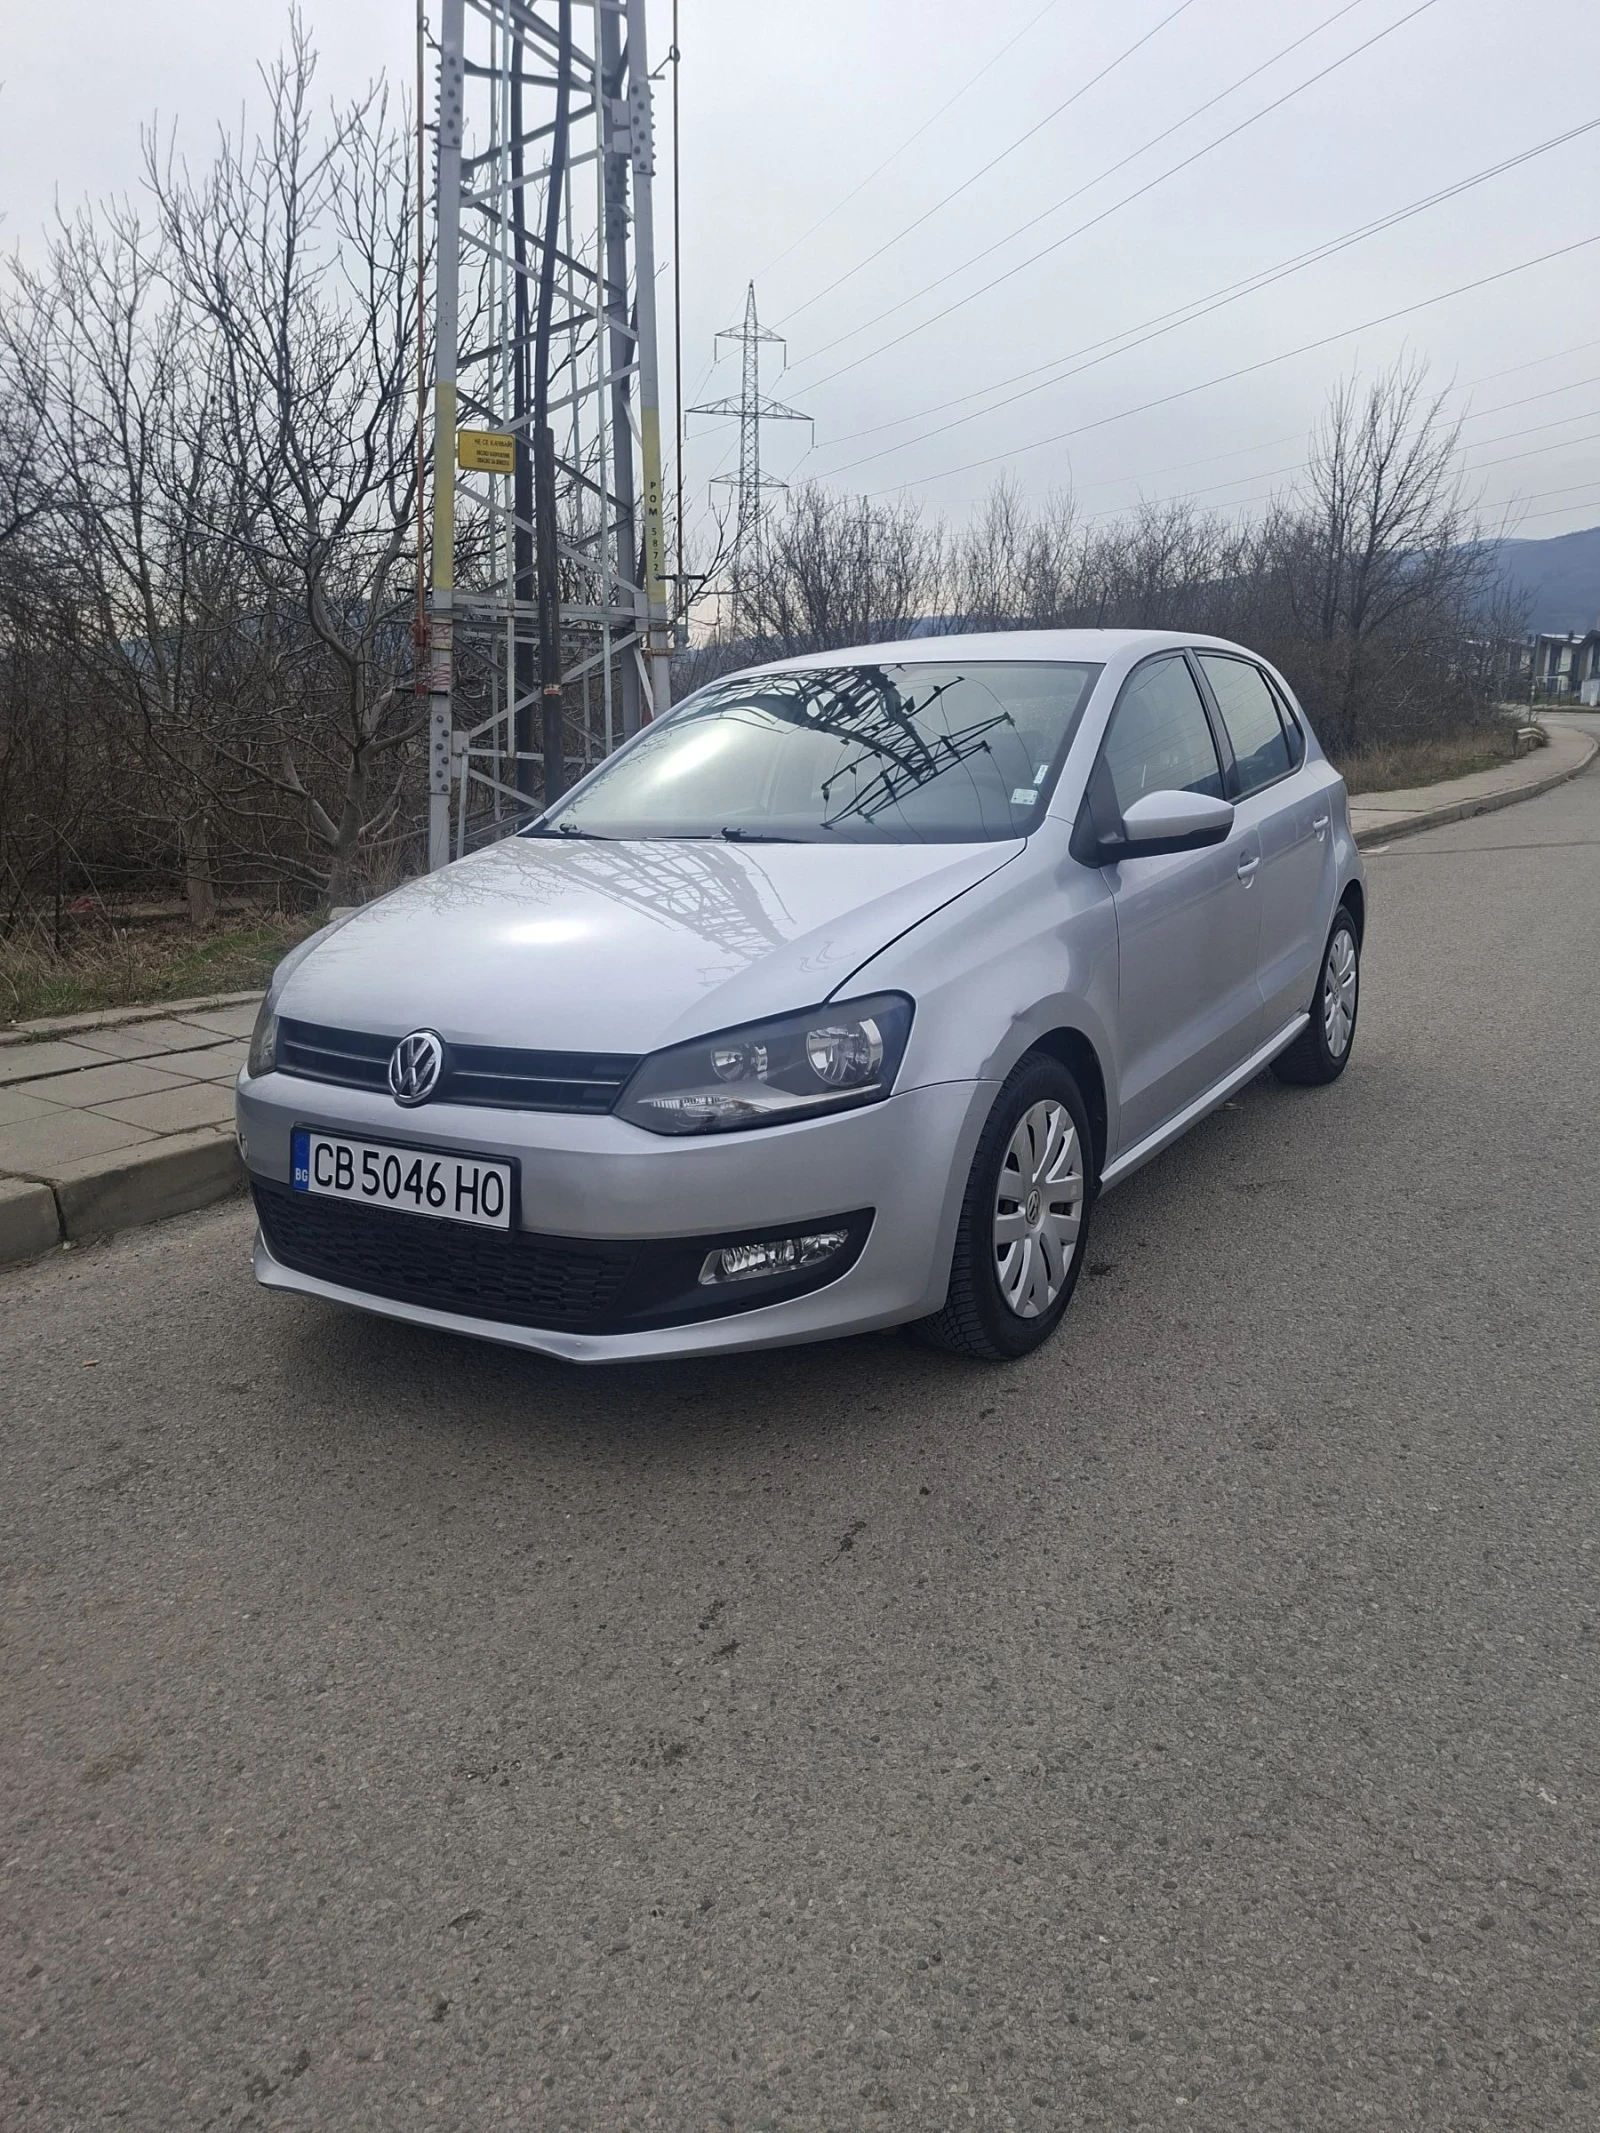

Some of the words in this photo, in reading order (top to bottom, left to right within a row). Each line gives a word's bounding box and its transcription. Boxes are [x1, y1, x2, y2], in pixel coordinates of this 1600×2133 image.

[651, 527, 659, 571] 5872
[295, 1167, 308, 1182] BG
[314, 1142, 355, 1190] CB
[361, 1150, 446, 1208] 5046
[455, 1165, 504, 1217] HO
